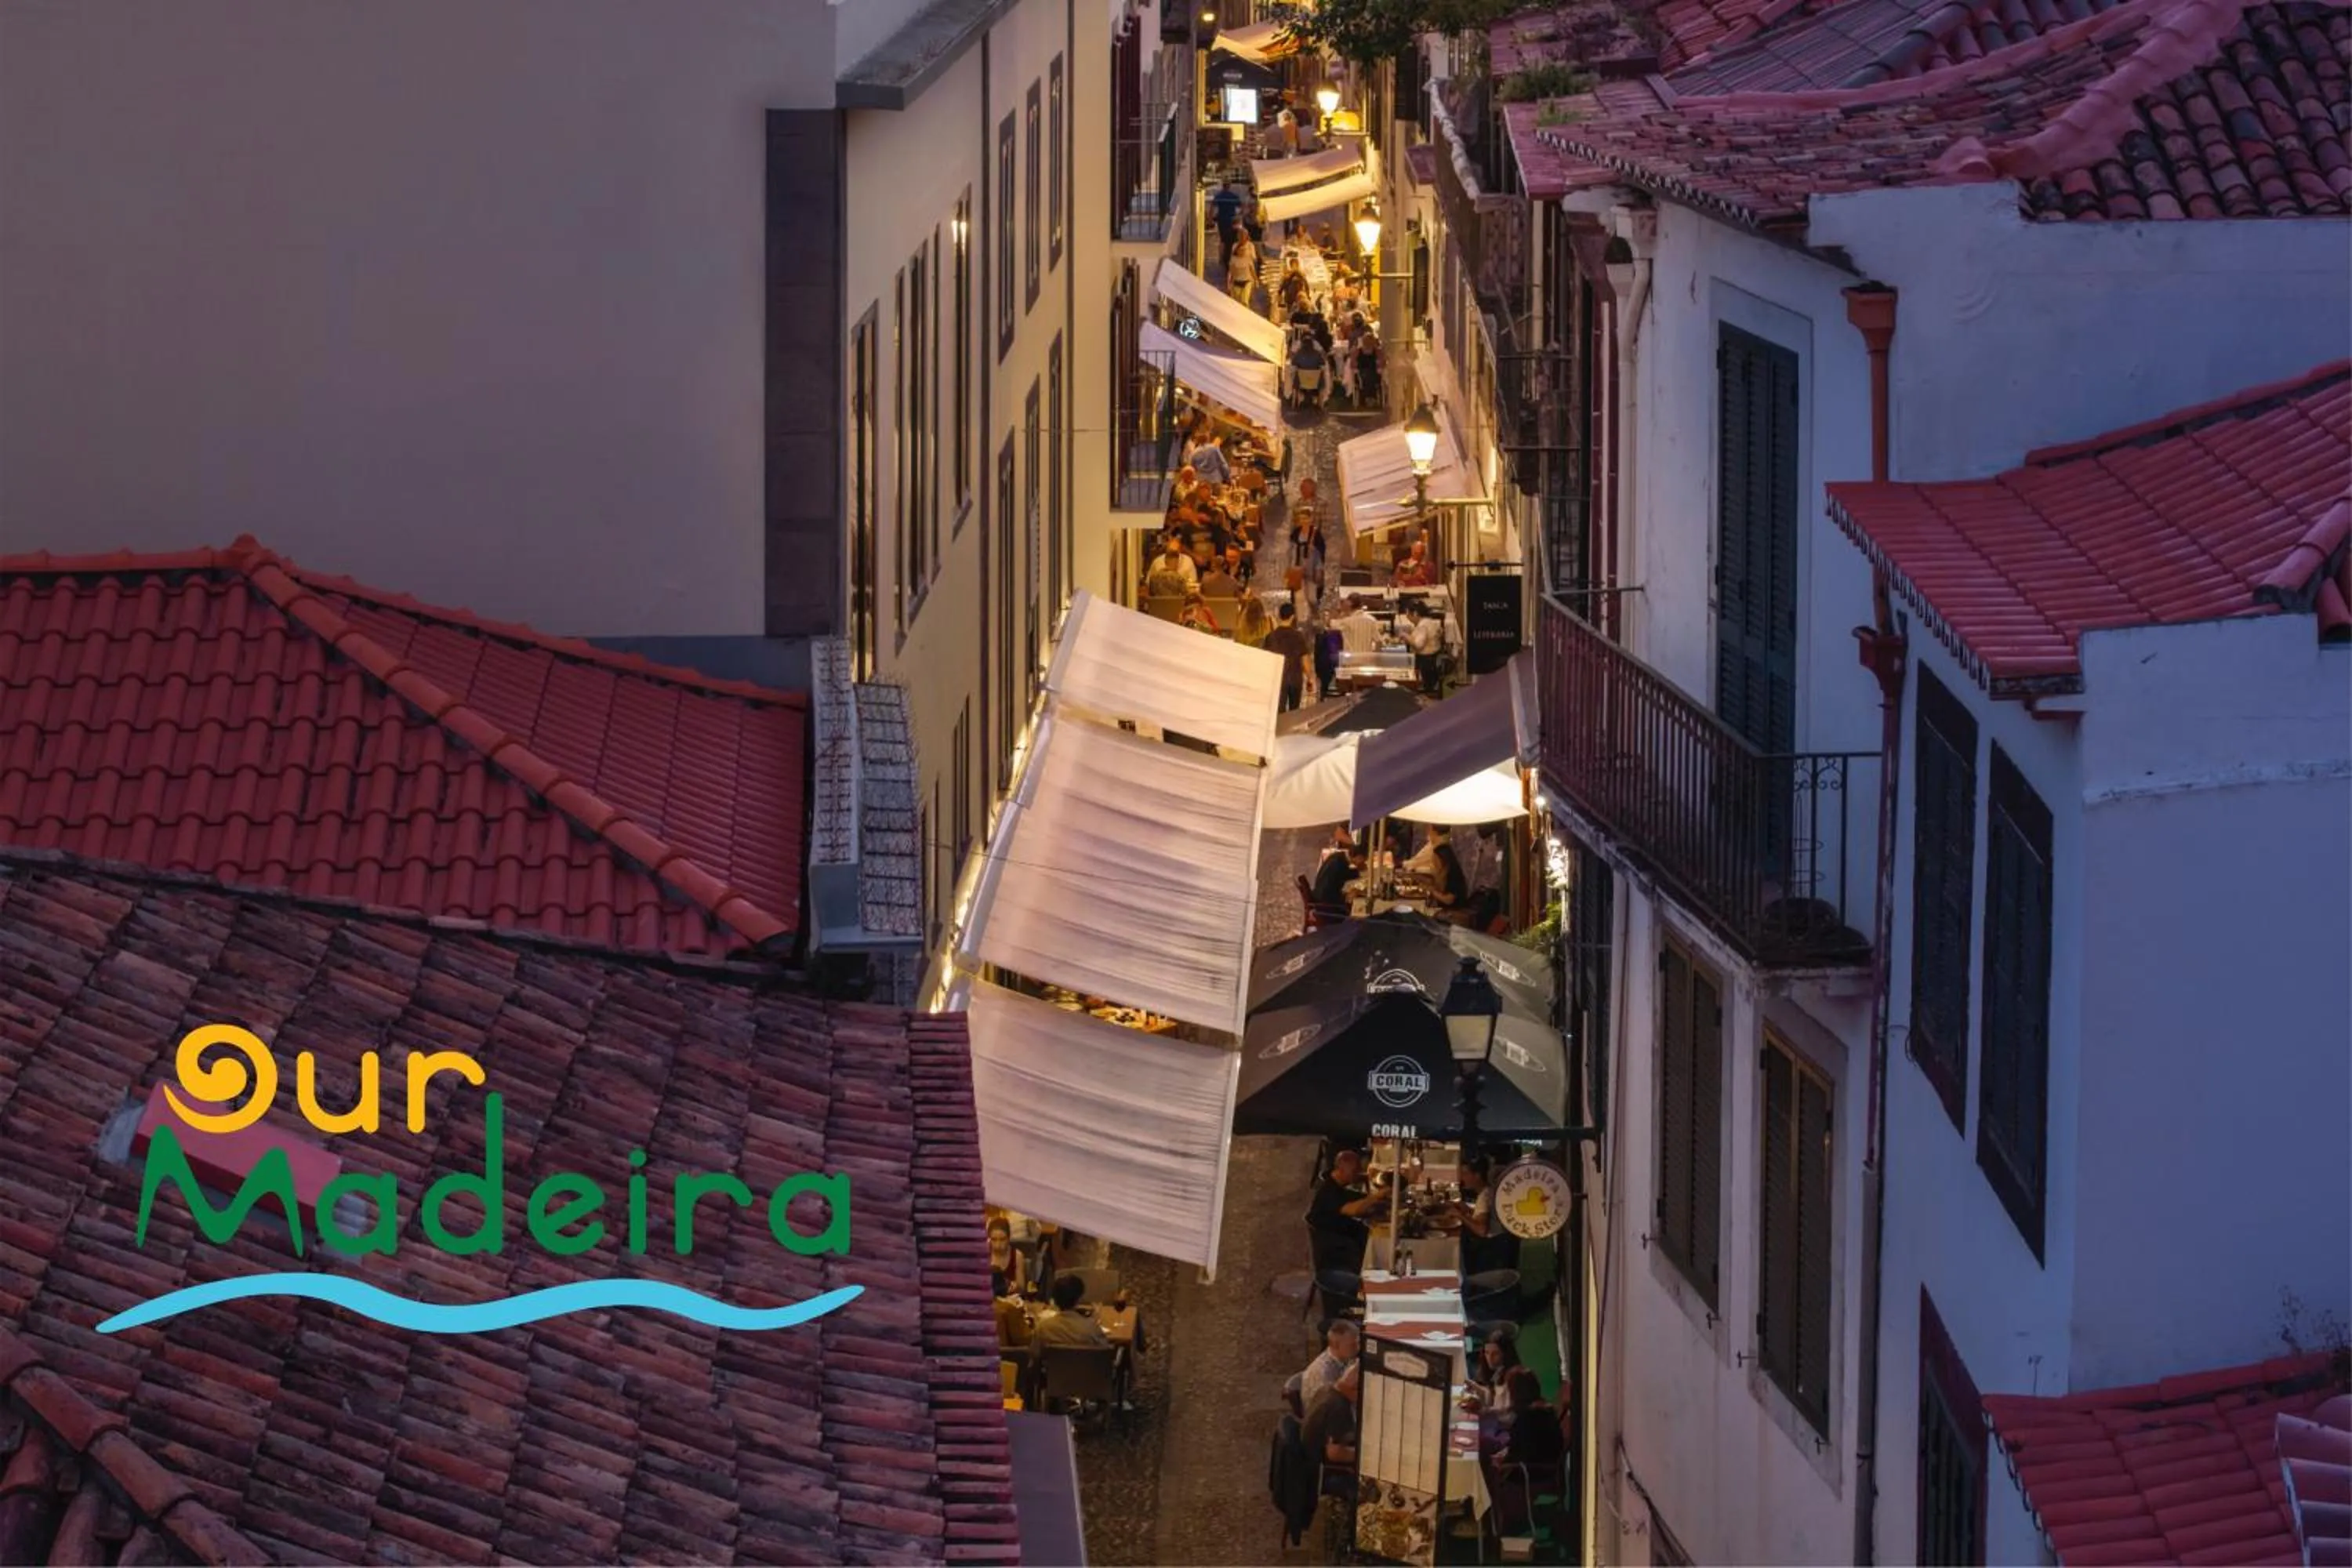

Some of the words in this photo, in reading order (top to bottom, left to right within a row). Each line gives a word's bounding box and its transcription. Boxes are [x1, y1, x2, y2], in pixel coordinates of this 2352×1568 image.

[1376, 1075, 1424, 1087] CORAL
[1372, 1123, 1418, 1139] CORAL
[1501, 1167, 1561, 1195] Madeira
[1501, 1203, 1530, 1233] Duck
